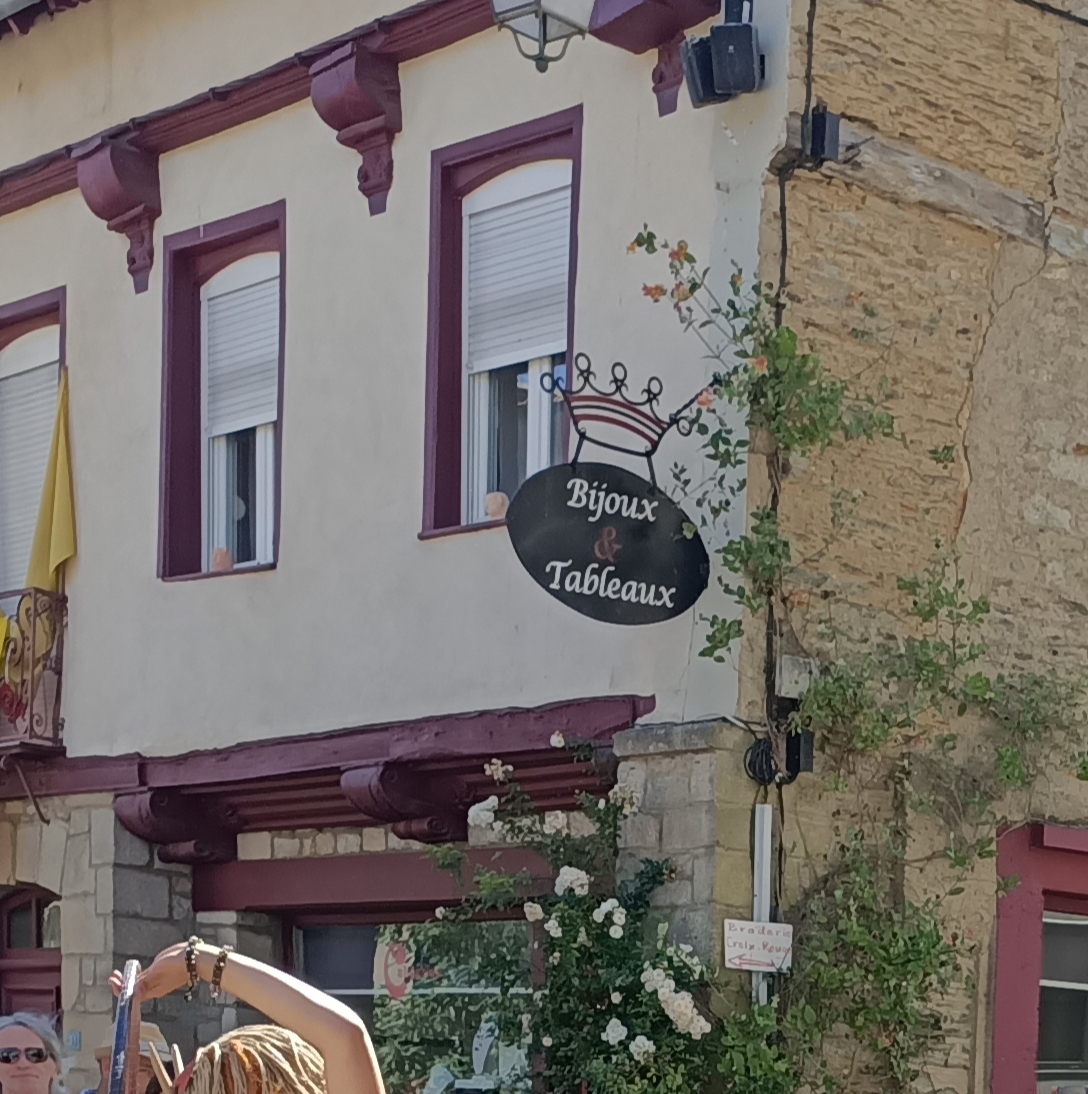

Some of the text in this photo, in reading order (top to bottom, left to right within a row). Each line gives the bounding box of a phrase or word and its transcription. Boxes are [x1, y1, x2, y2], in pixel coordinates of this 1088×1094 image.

[566, 478, 659, 522] Bijoux
[594, 526, 623, 563] &
[545, 559, 677, 608] Tableaux
